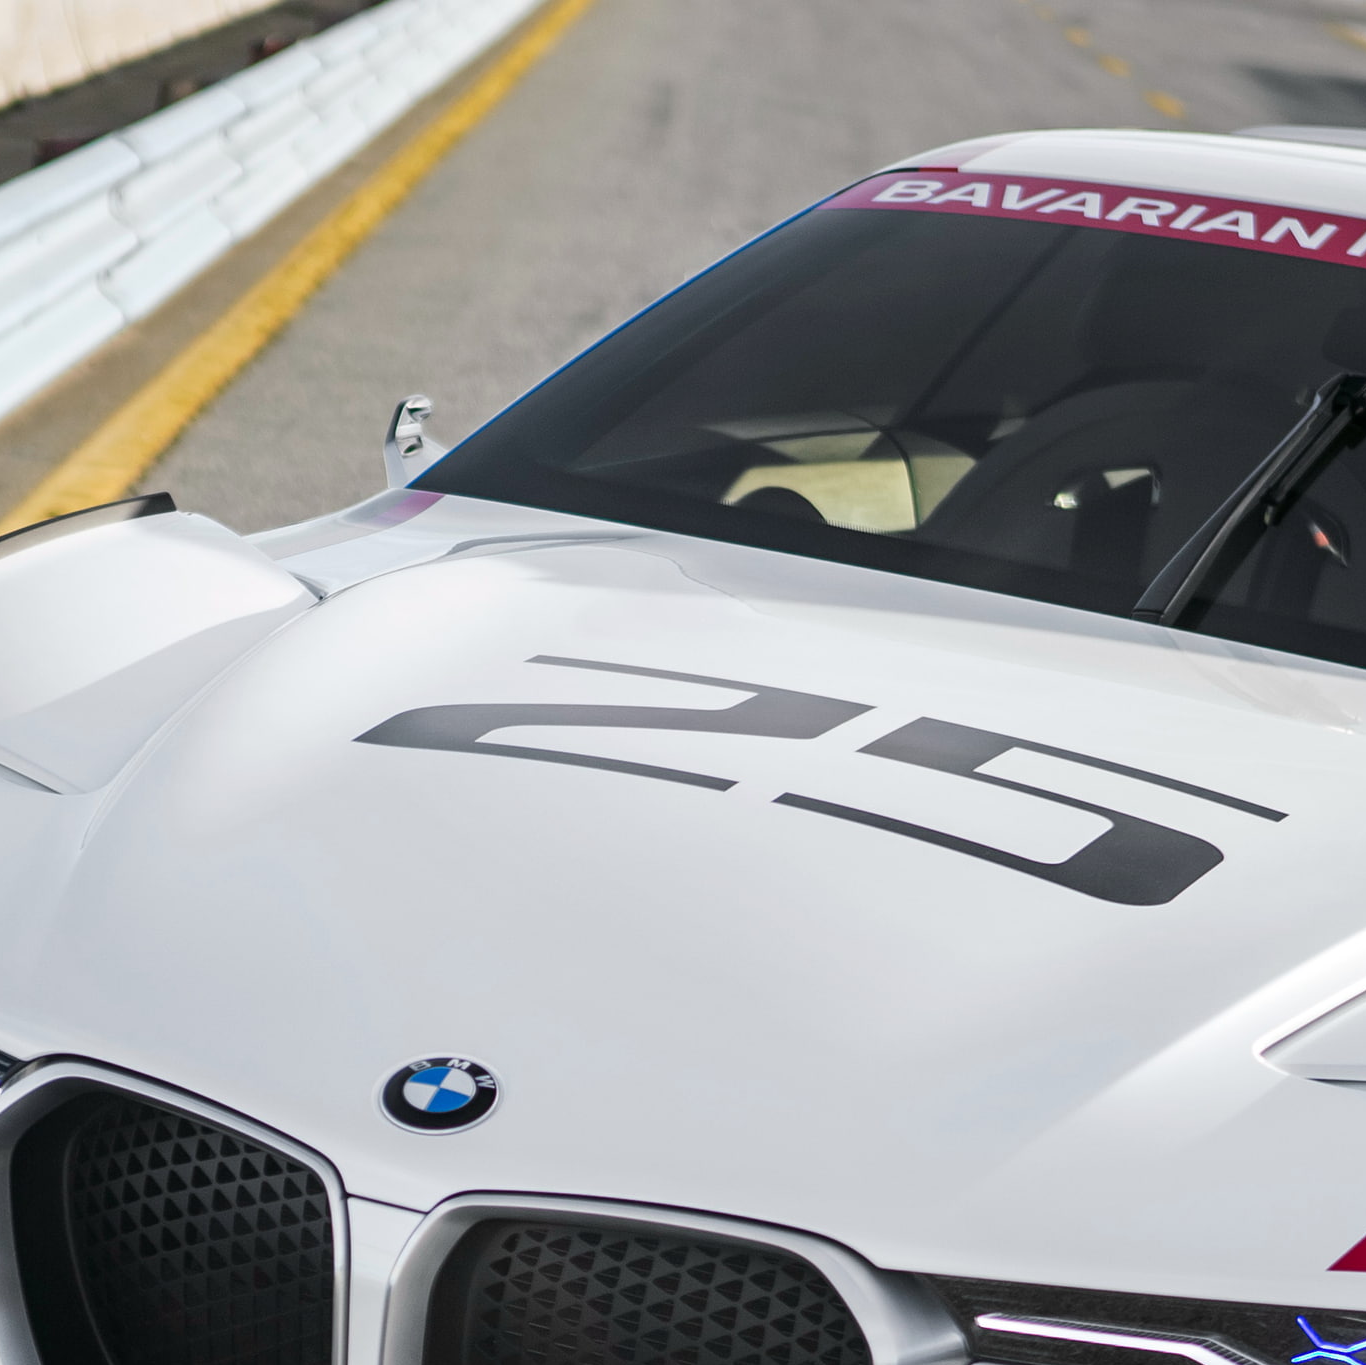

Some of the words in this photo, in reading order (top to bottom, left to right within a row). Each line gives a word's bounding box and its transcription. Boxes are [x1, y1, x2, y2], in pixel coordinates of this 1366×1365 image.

[872, 179, 1338, 250] BAVARIAN
[351, 654, 1289, 906] 25
[409, 1058, 495, 1089] BMW
